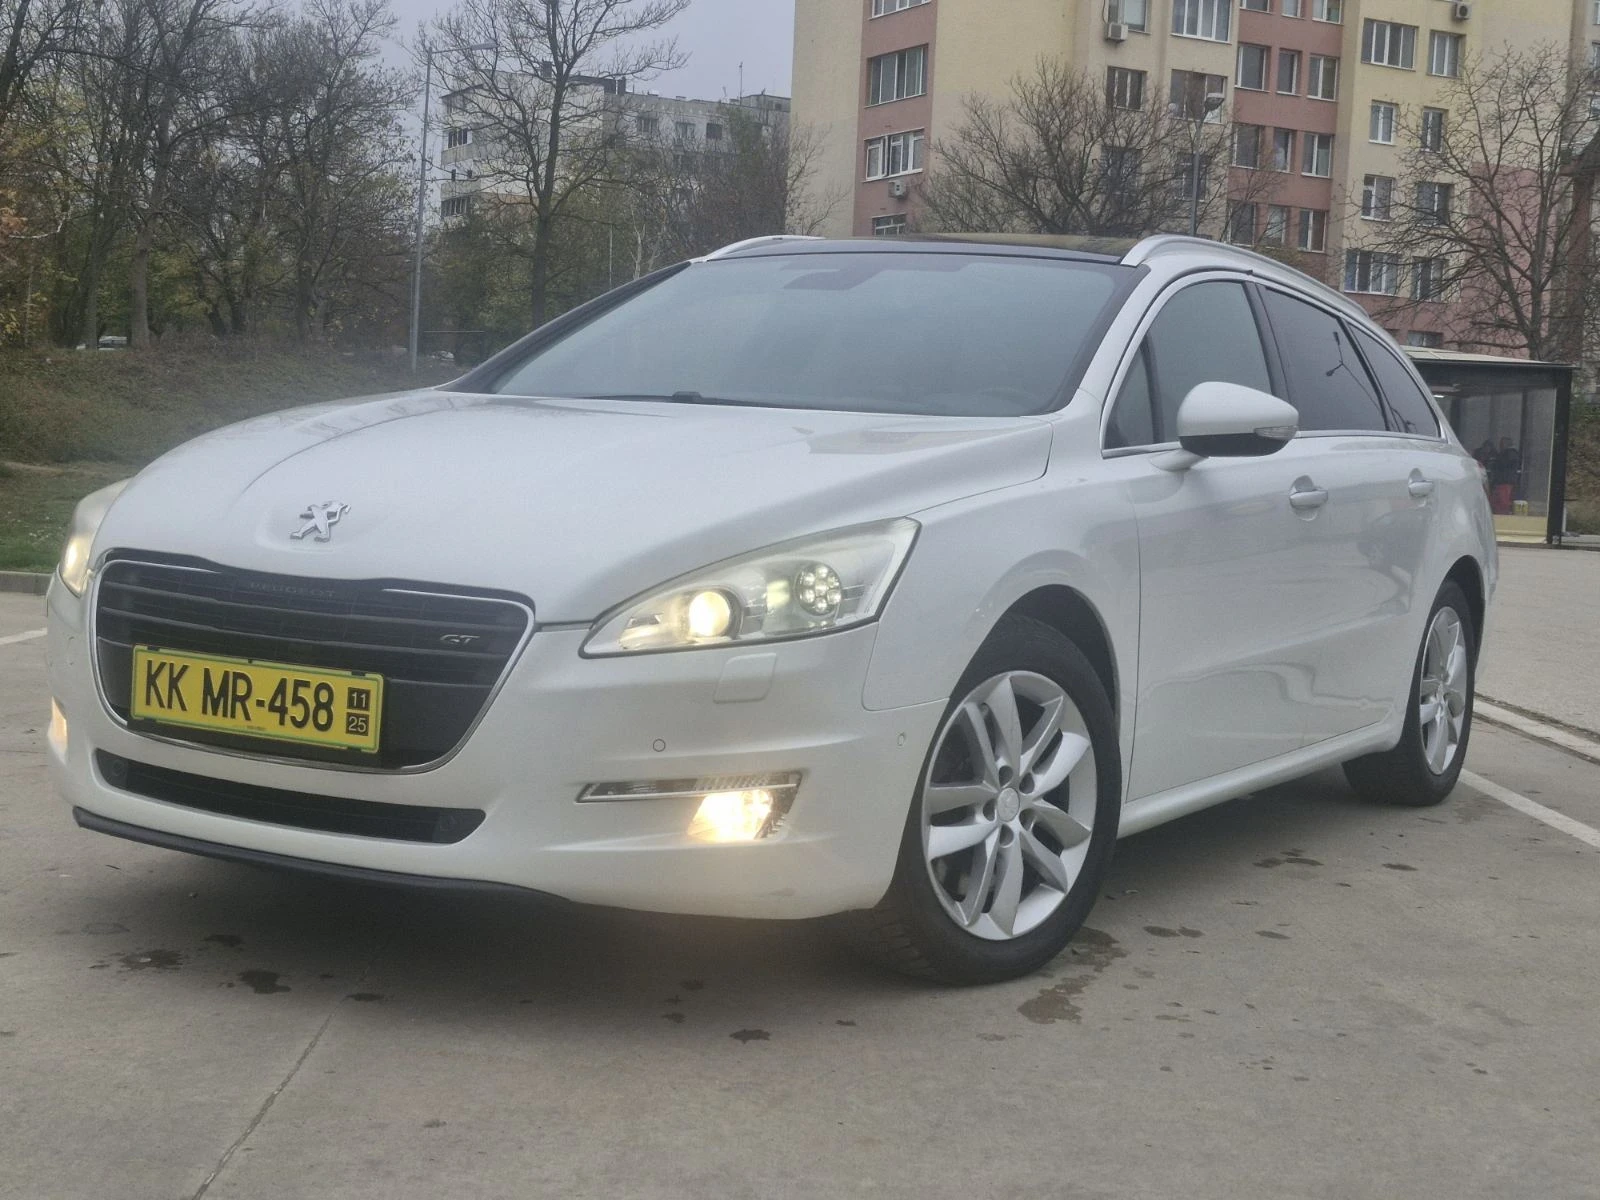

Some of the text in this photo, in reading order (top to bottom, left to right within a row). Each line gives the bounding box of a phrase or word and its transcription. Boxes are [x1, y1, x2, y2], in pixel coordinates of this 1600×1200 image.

[440, 634, 480, 645] GT
[145, 659, 335, 733] KK MR-458
[351, 692, 367, 708] 11
[348, 716, 367, 733] 25
